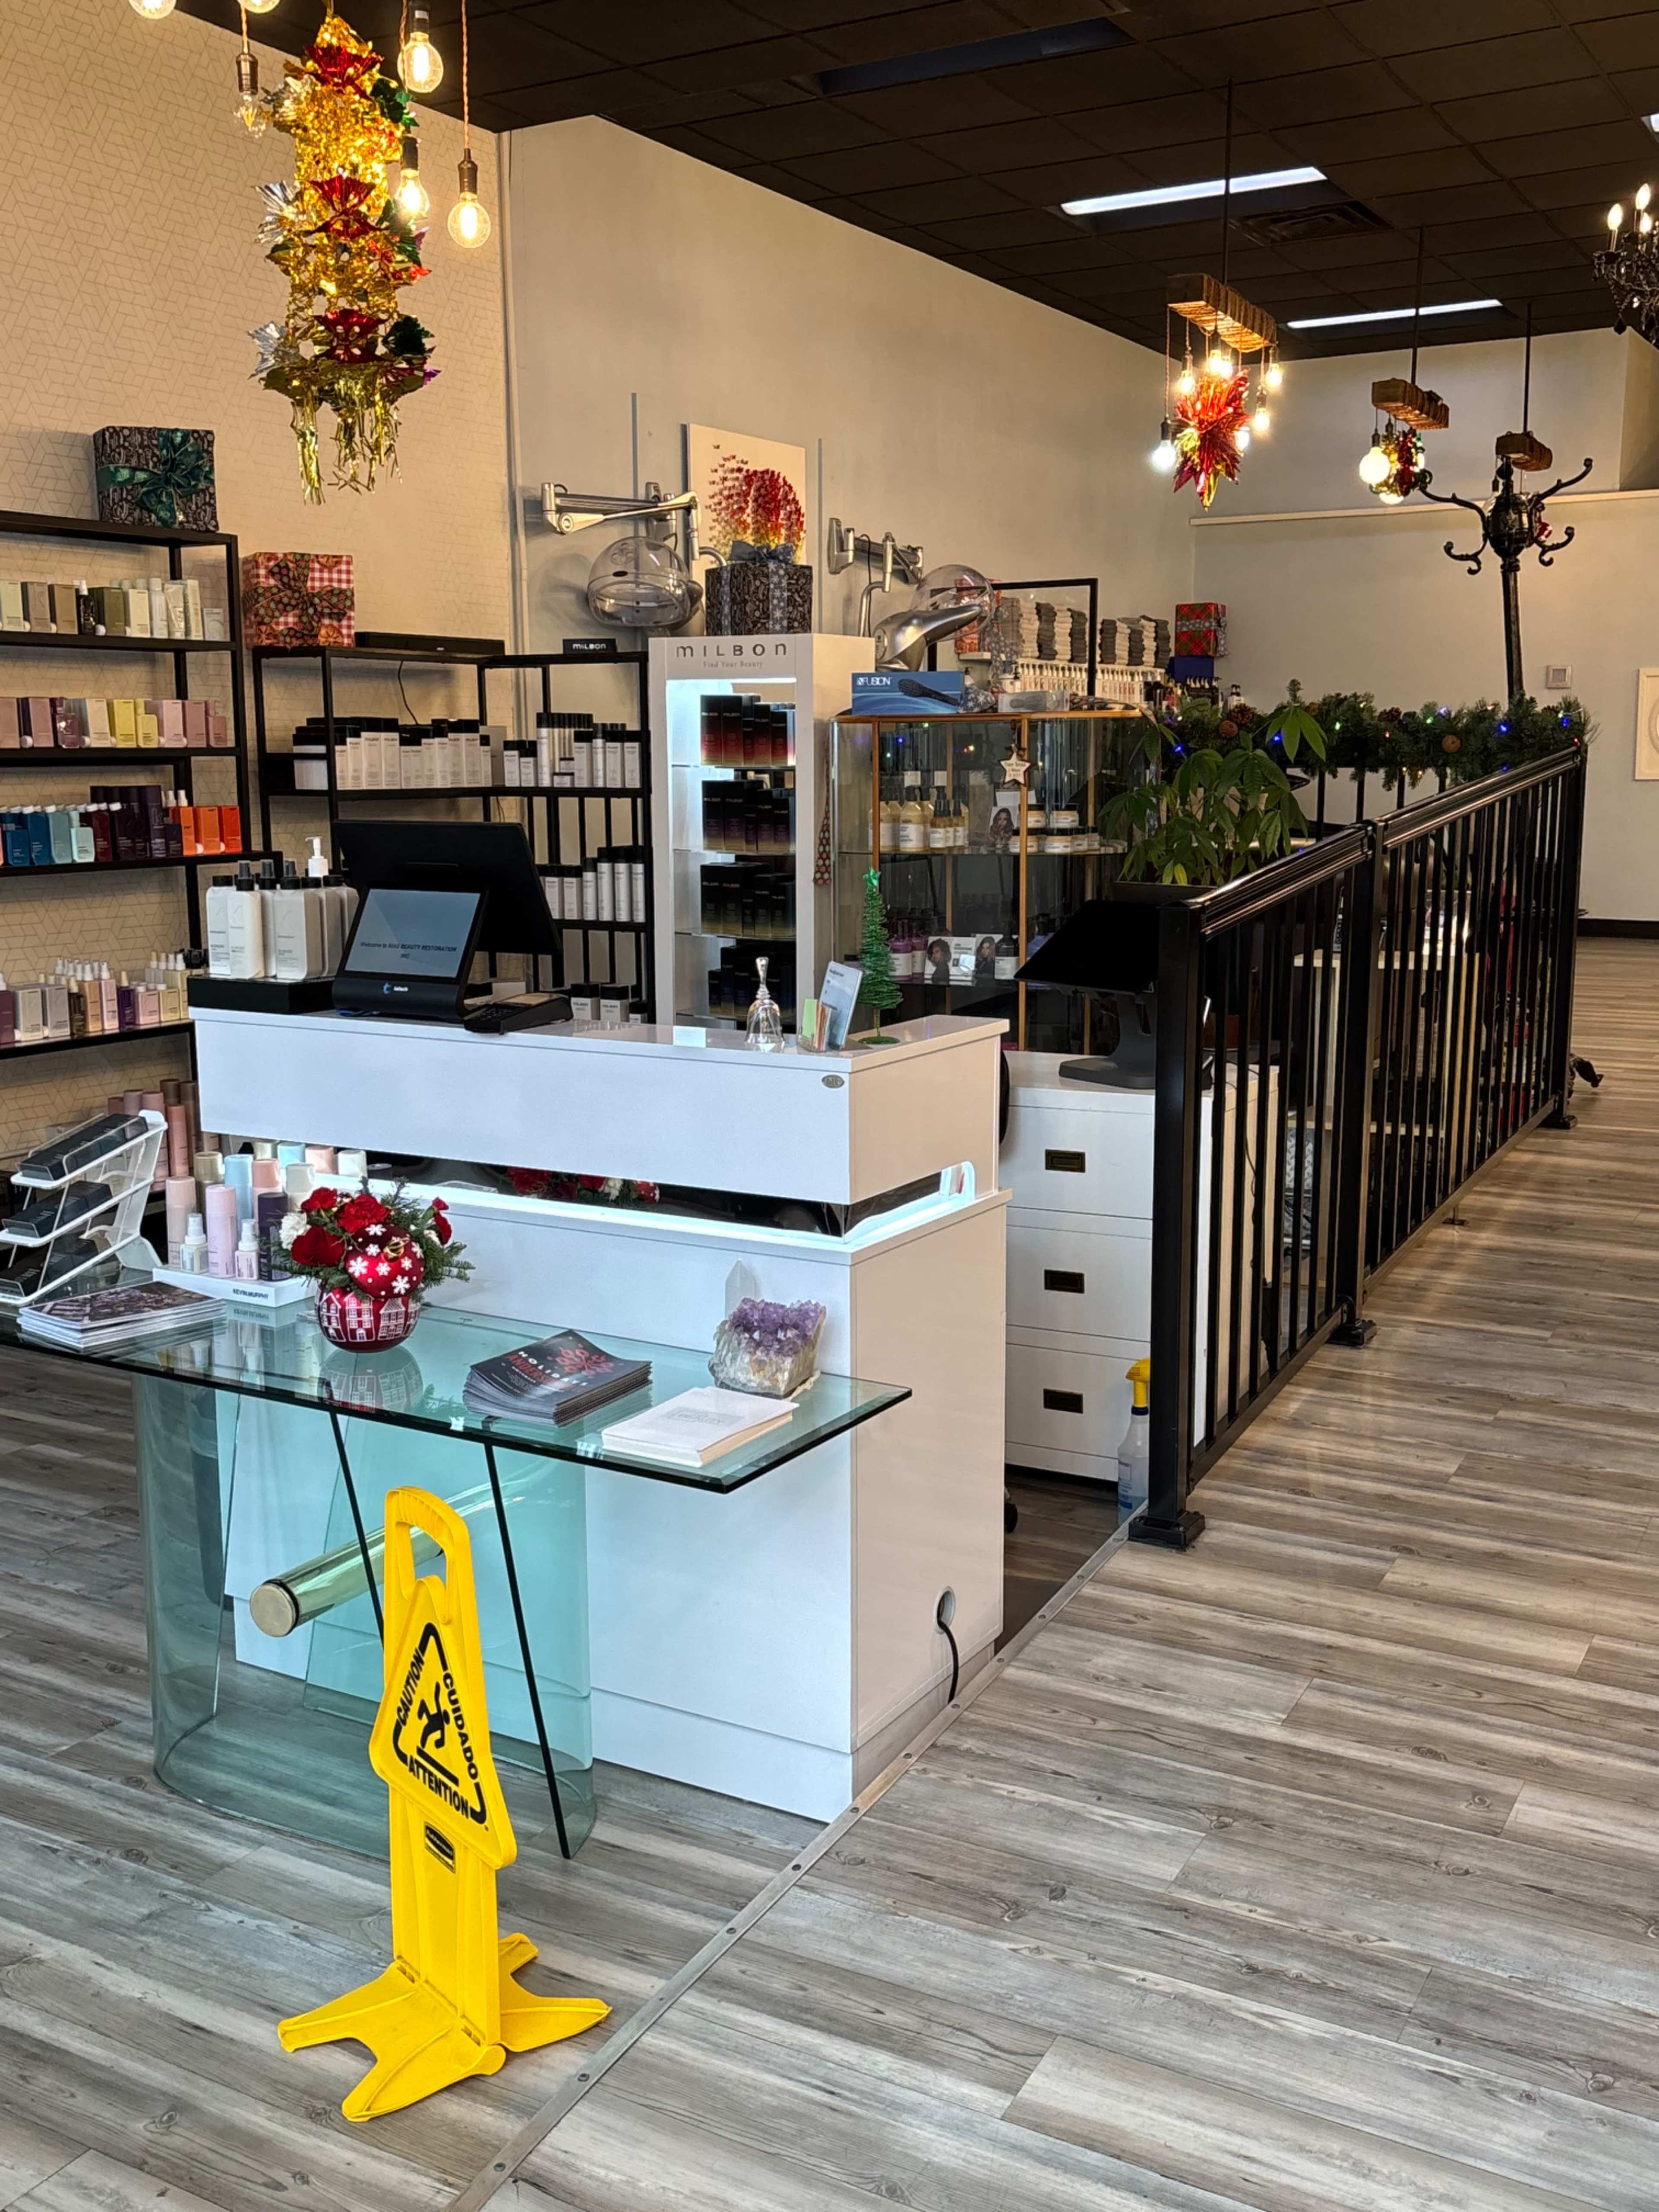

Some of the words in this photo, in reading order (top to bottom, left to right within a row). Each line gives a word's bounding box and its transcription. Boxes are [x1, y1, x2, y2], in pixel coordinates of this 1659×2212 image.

[396, 1646, 425, 1727] CAUTION
[442, 1670, 478, 1781] CUIDADO
[408, 1754, 470, 1820] ATTENTION
